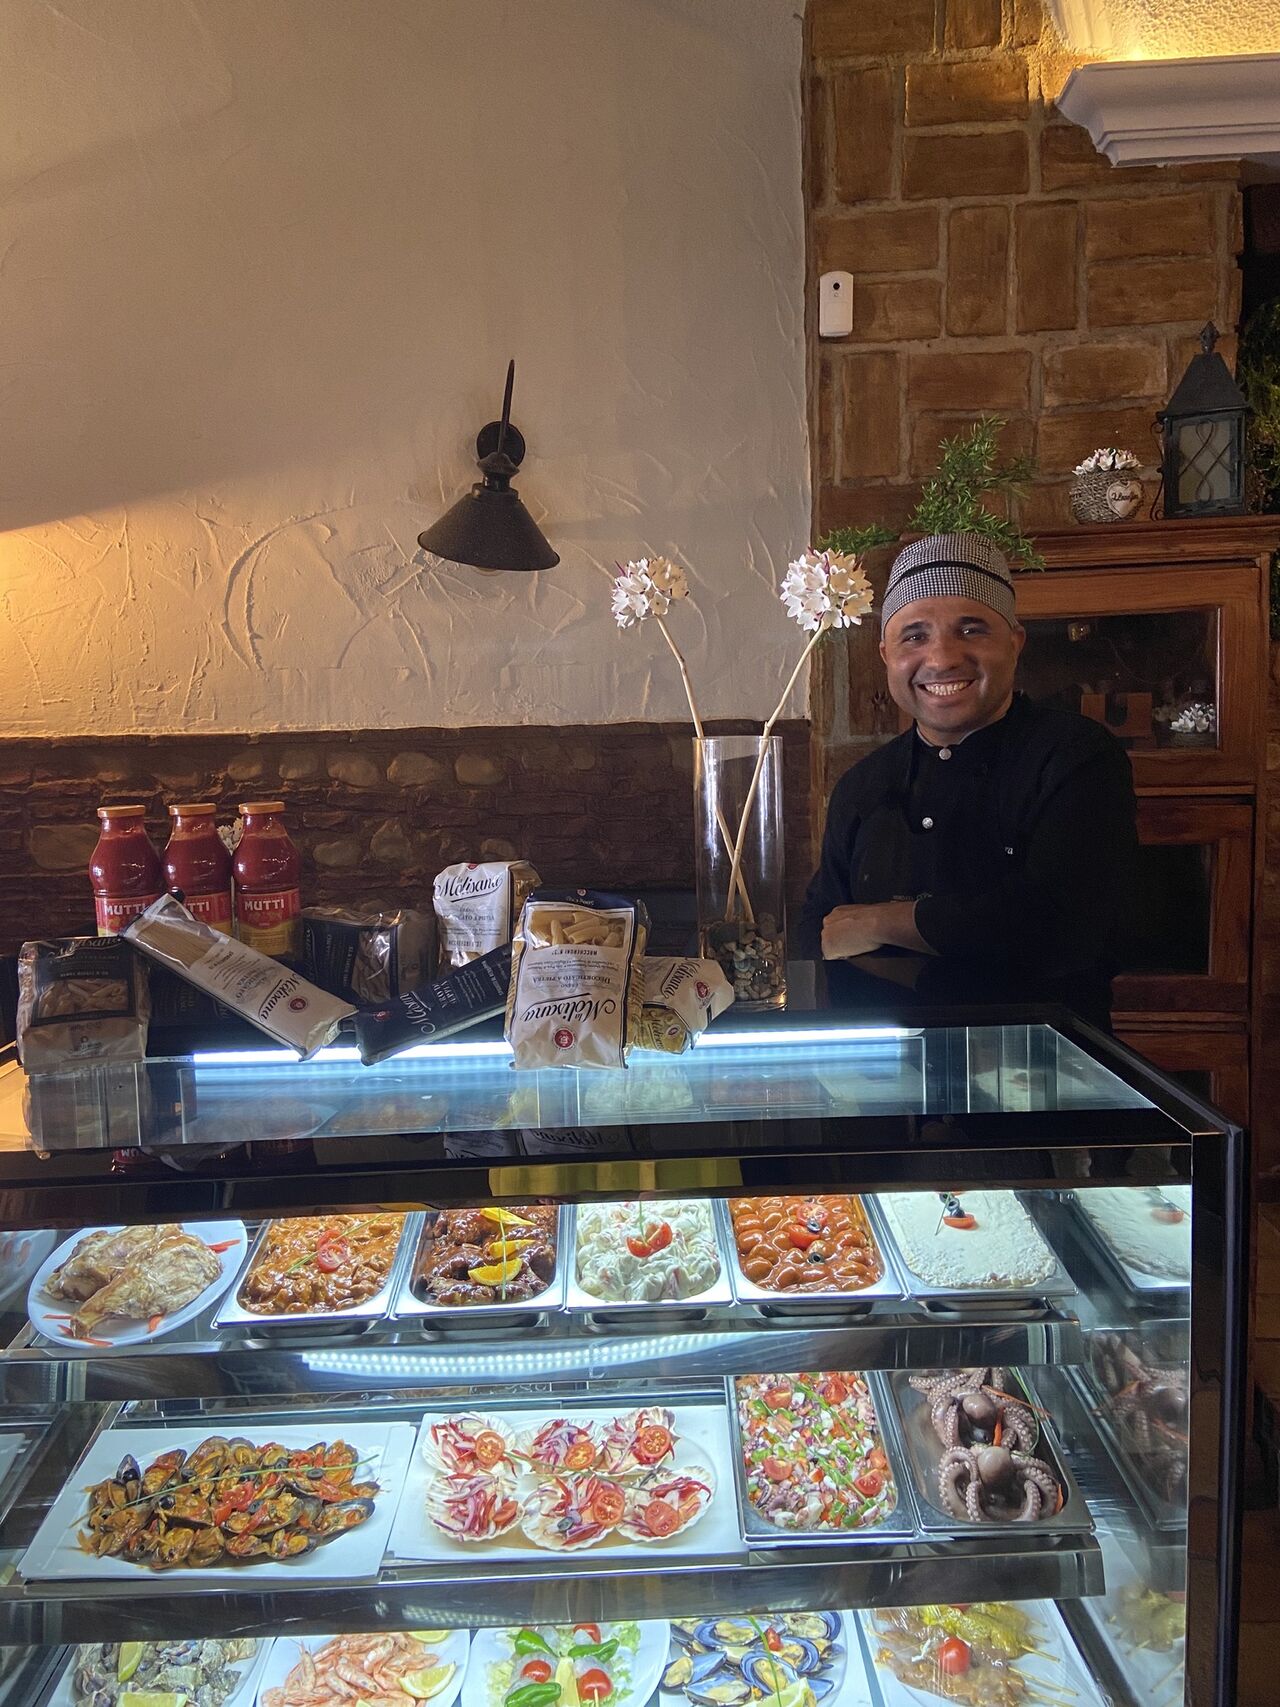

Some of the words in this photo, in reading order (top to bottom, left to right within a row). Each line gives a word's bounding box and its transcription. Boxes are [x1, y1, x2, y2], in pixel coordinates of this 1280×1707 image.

[434, 876, 503, 897] Molisana
[184, 901, 210, 912] TTI
[244, 898, 285, 911] MUTTI
[663, 961, 701, 997] Molisana
[259, 973, 301, 1020] Molisana
[521, 999, 617, 1023] Molisana
